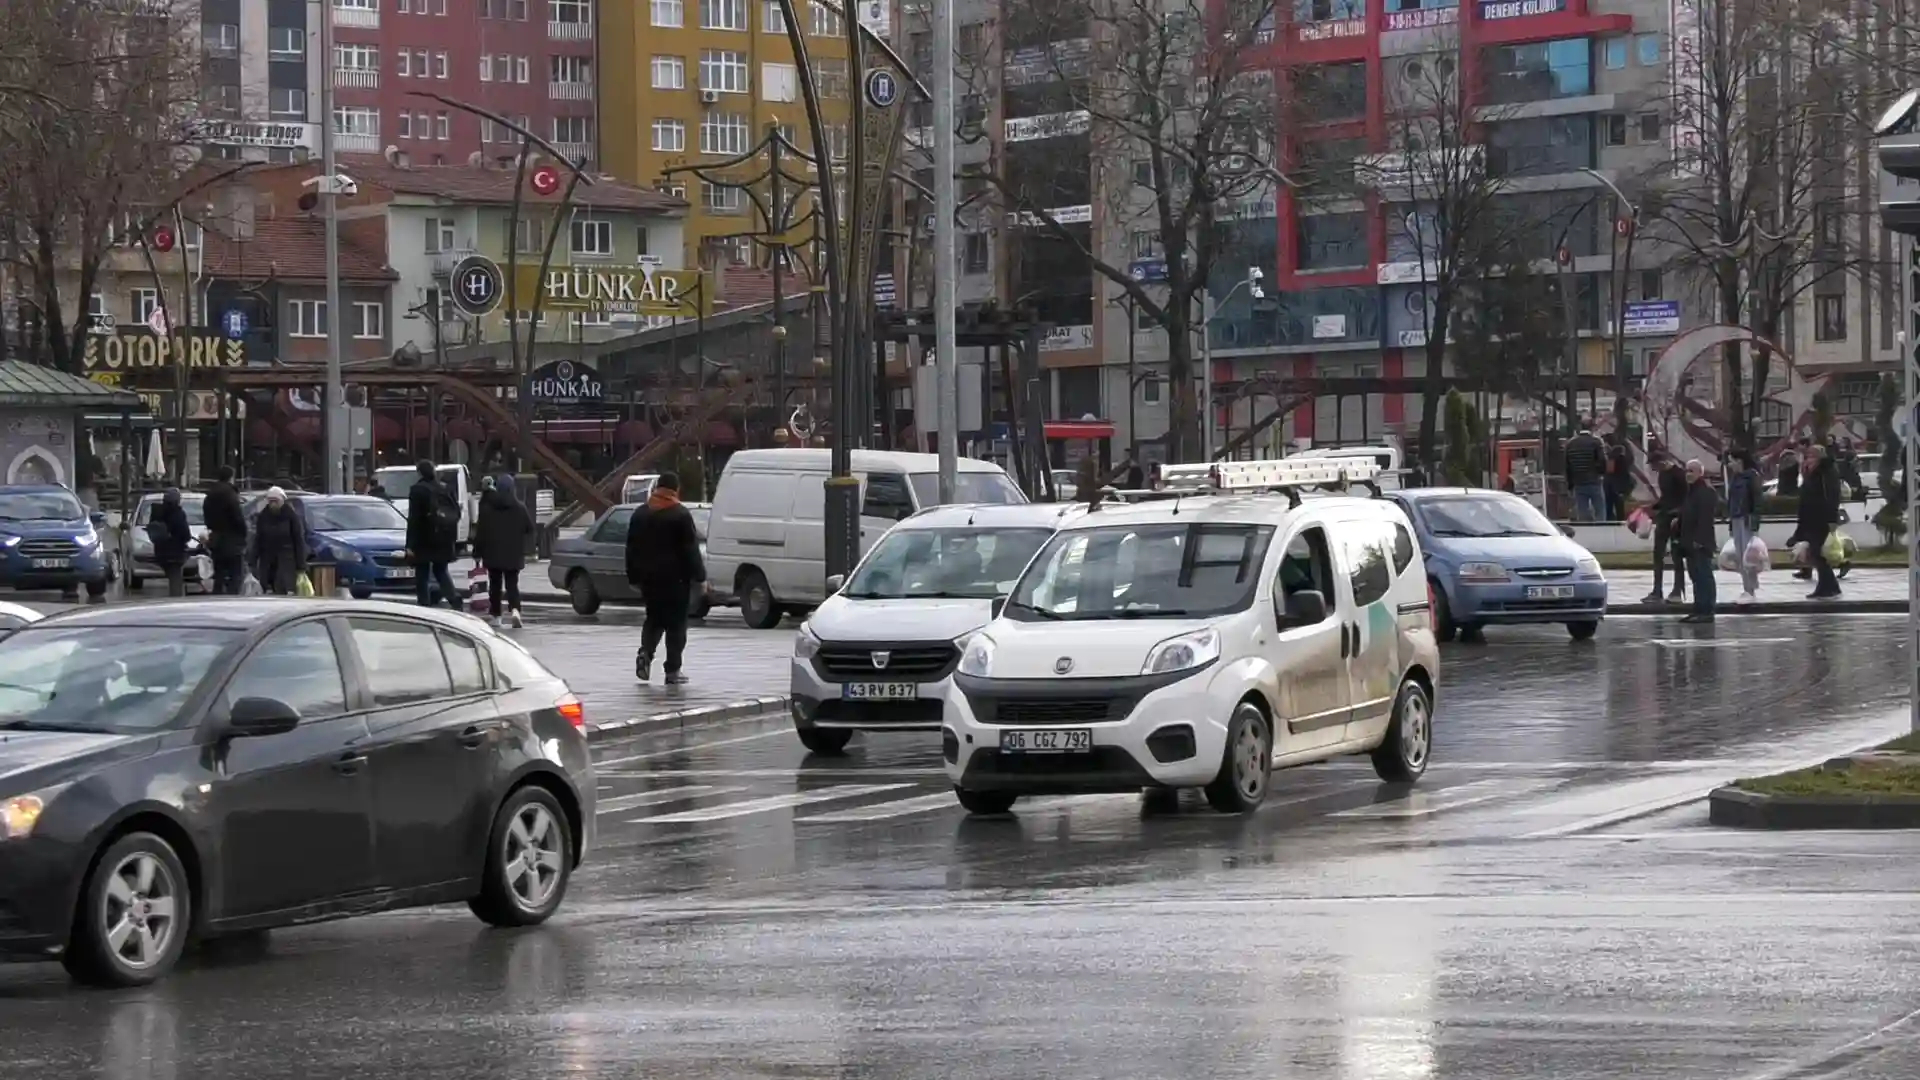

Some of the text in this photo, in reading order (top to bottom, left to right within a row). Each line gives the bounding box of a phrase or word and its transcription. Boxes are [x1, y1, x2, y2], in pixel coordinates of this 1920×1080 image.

[104, 335, 221, 368] OTOPARK
[850, 684, 865, 697] 43
[869, 684, 884, 697] RV
[1010, 731, 1088, 748] 06 CGZ 792
